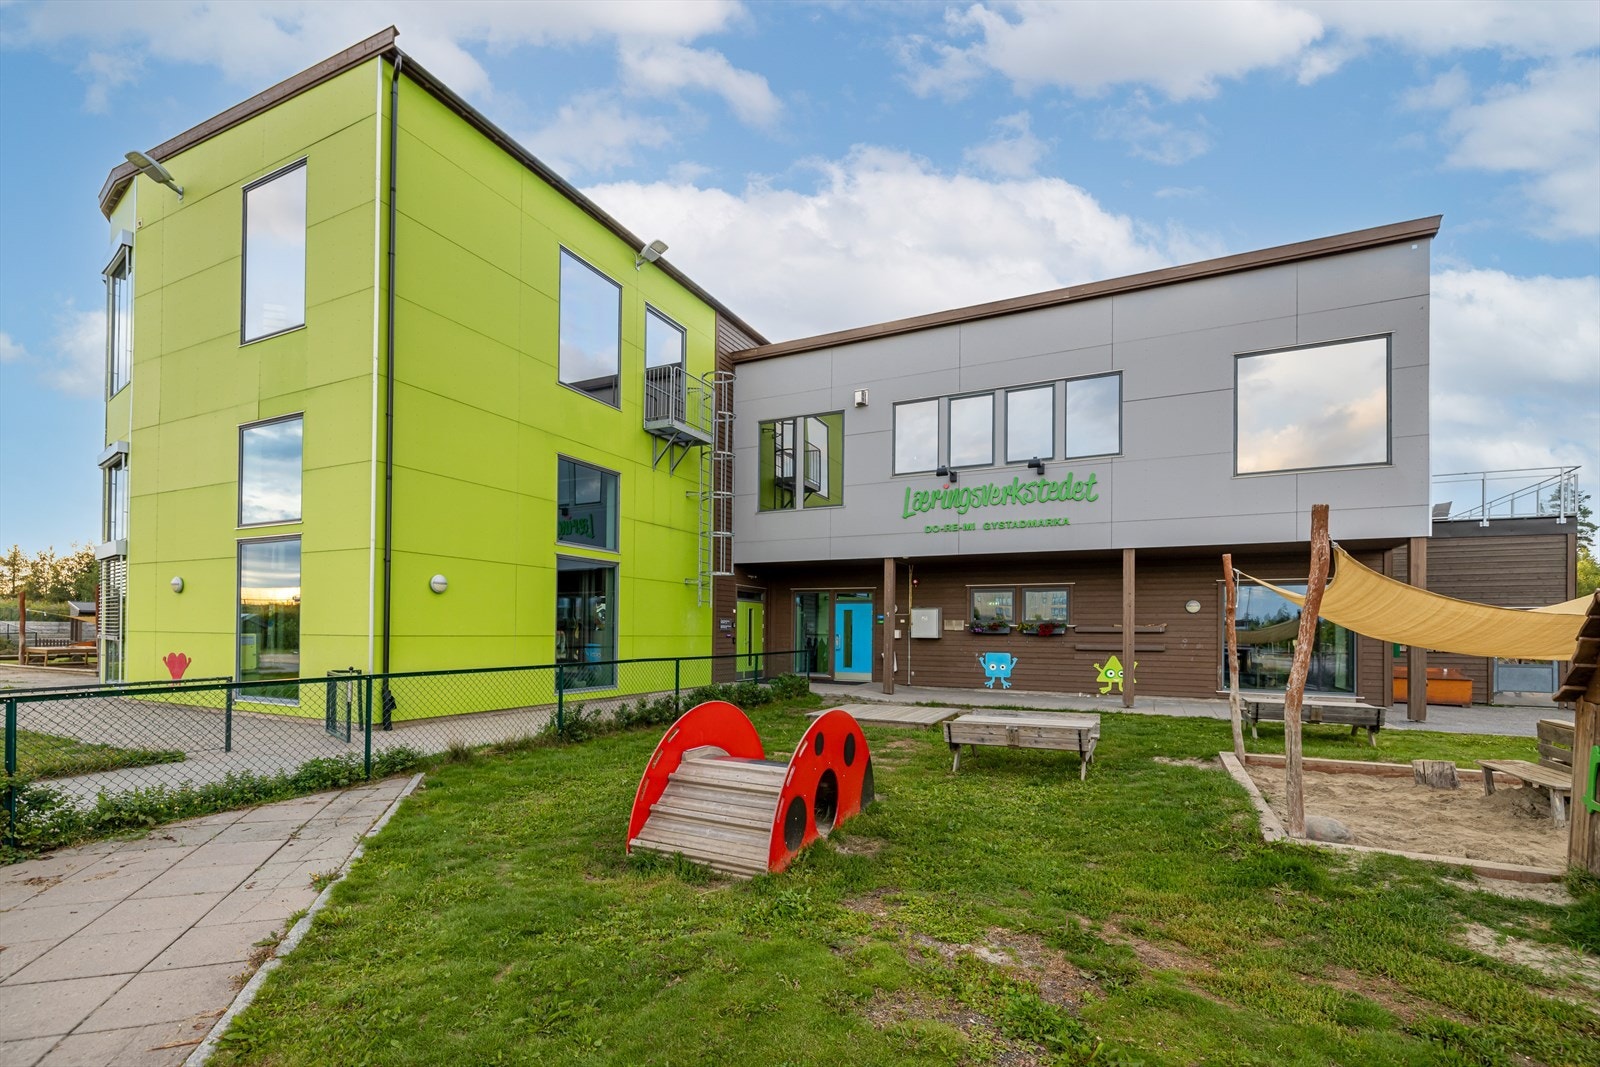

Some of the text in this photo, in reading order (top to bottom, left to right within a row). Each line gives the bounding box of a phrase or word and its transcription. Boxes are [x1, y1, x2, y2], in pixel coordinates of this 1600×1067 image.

[902, 472, 1099, 519] Læringsverkstedet
[924, 517, 1070, 533] DO-RE-MI GYSTADMARKA
